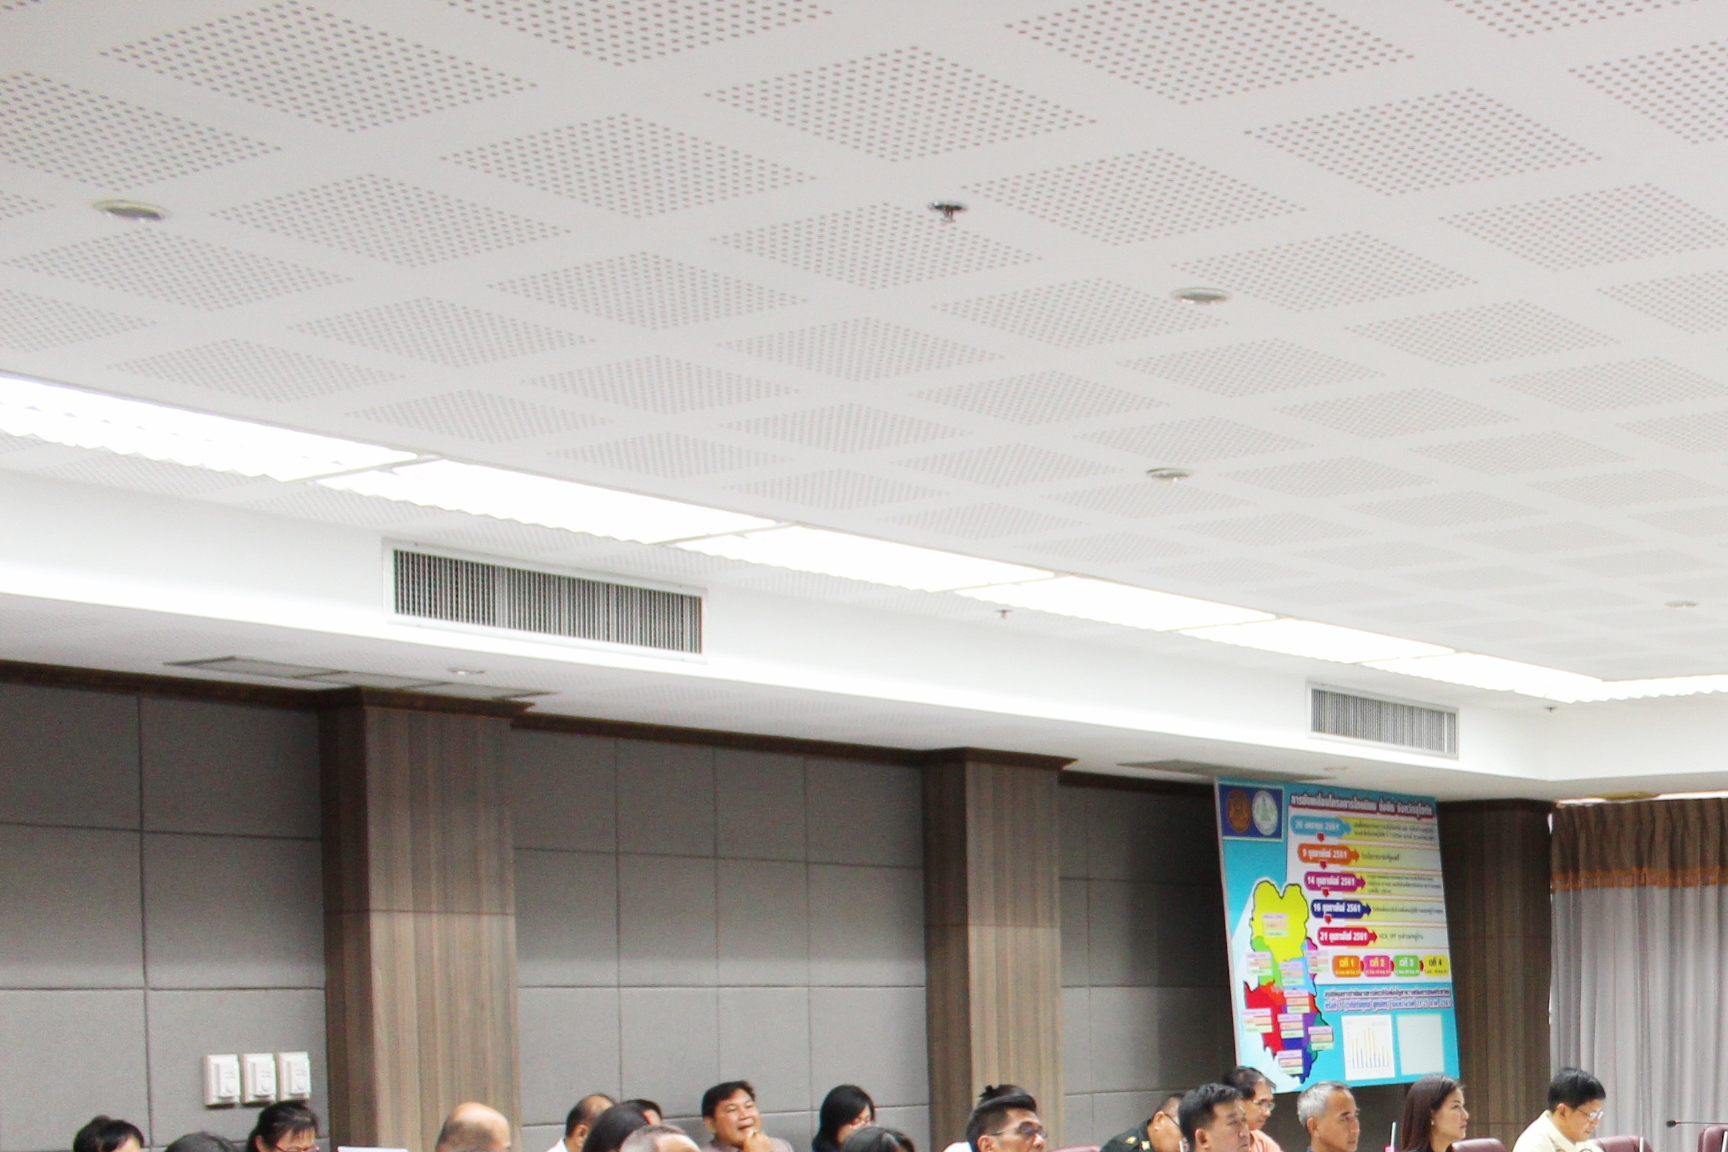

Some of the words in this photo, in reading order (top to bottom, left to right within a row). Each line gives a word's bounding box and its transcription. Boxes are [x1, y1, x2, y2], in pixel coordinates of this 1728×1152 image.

[1333, 850, 1348, 859] 2561
[1307, 876, 1315, 885] 14
[1340, 877, 1355, 886] 2561
[1346, 904, 1361, 912] 2561
[1320, 931, 1328, 941] 21
[1353, 932, 1368, 942] 2561
